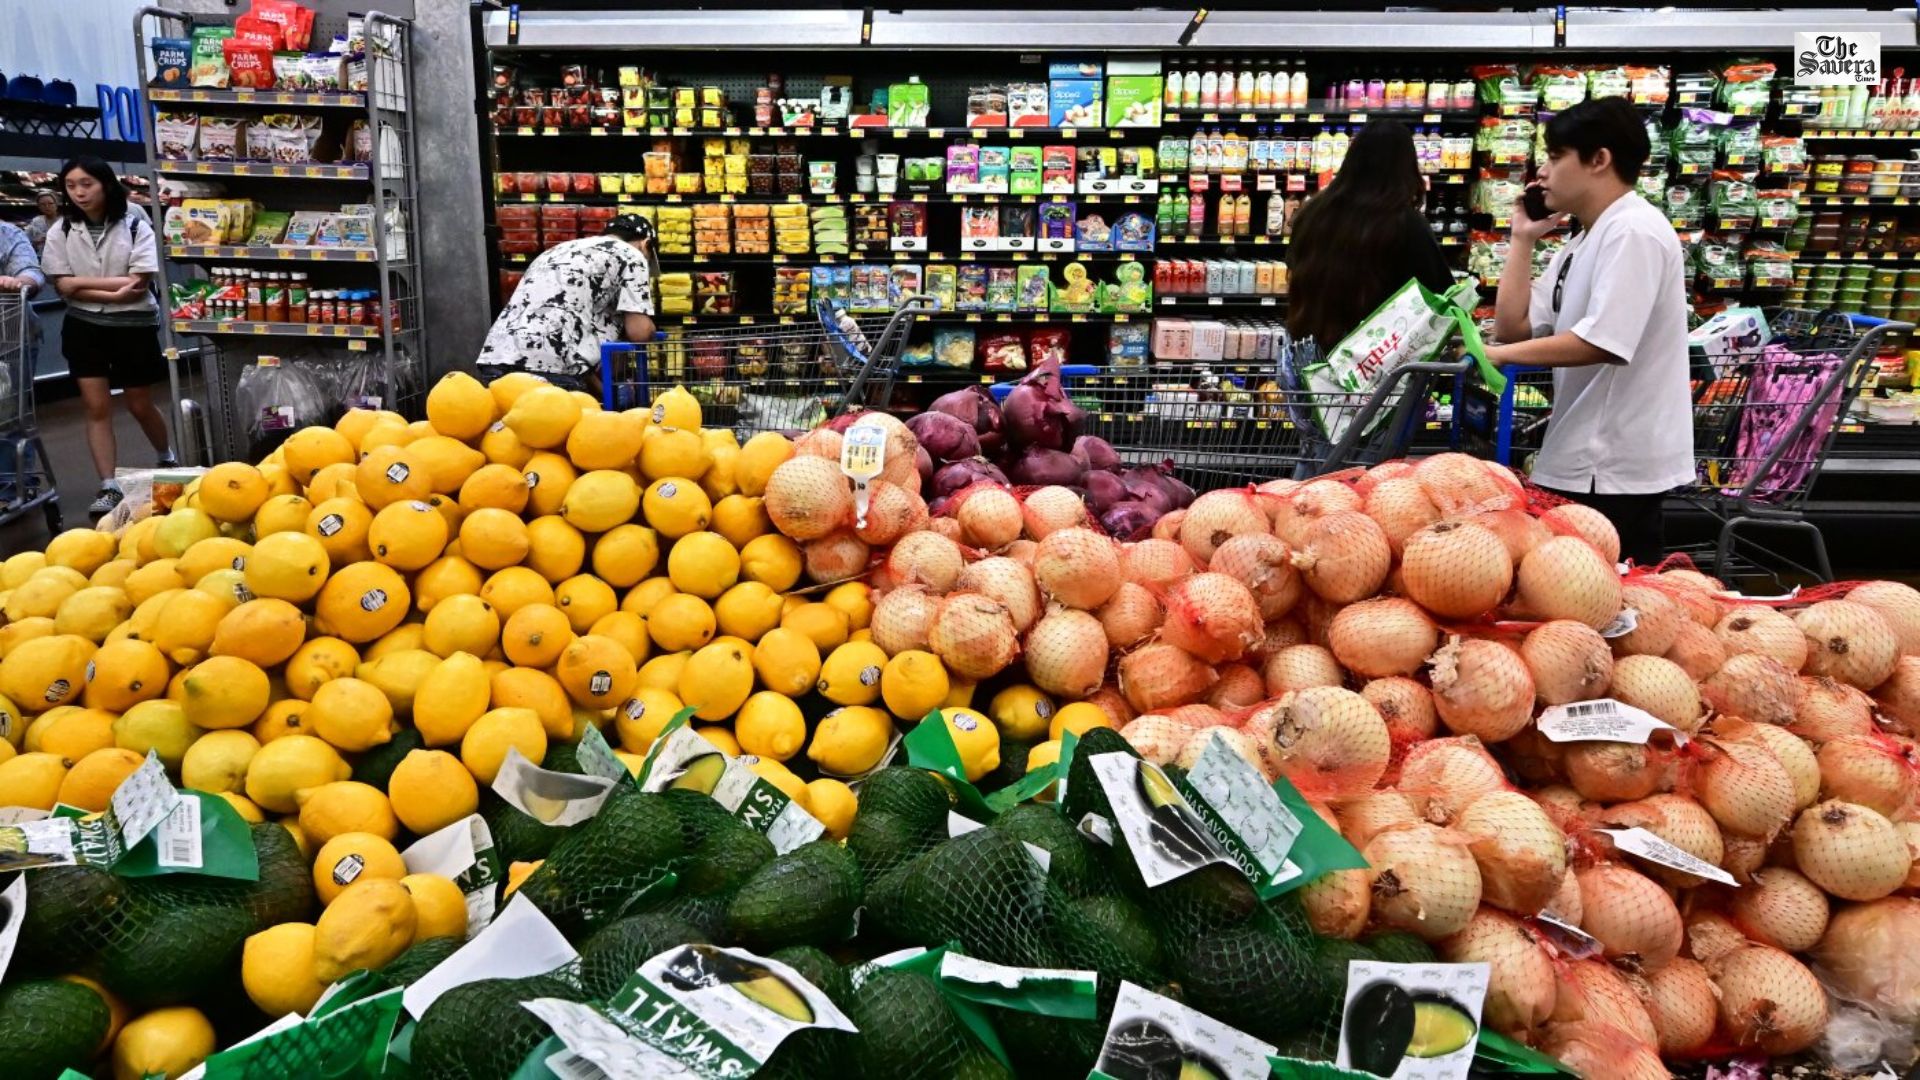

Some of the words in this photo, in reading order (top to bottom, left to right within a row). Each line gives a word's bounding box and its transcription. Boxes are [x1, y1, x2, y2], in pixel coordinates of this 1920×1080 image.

[159, 50, 185, 58] PARM
[231, 53, 259, 63] PARM
[157, 57, 187, 66] CRISPS
[231, 61, 262, 69] CRISPS
[1184, 790, 1209, 824] HASS
[1206, 820, 1262, 883] AVOCADOS
[624, 986, 743, 1077] SMALL
